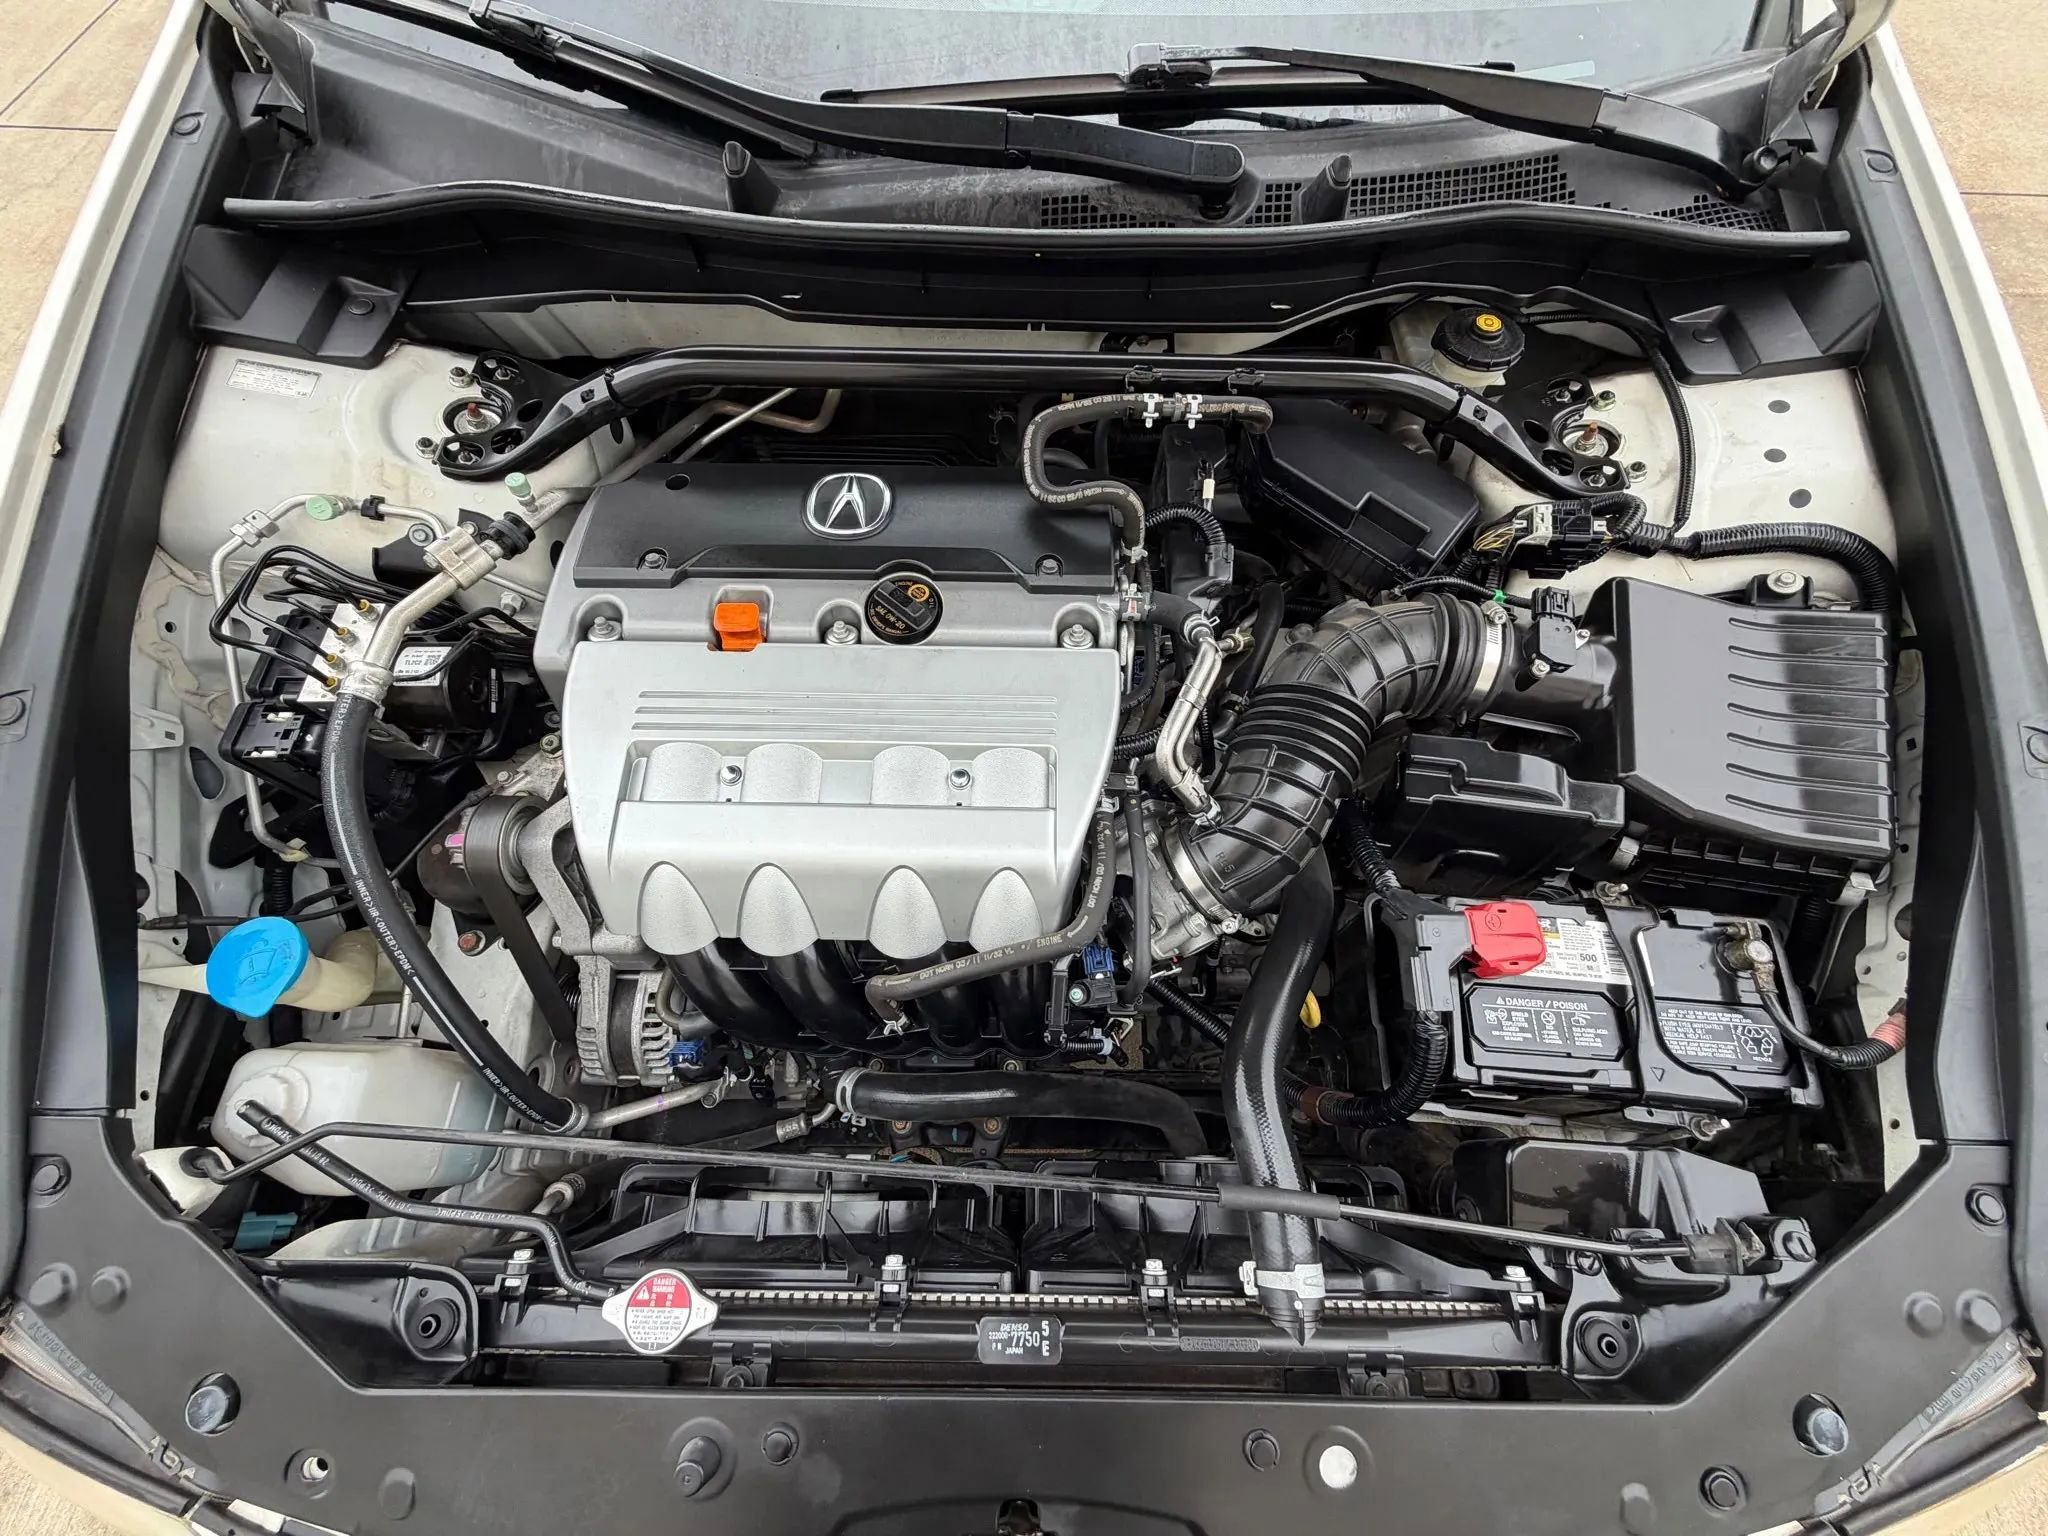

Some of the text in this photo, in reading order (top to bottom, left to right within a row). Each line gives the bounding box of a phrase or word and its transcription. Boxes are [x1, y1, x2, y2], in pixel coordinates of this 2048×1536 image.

[875, 605, 906, 630] SAE 0W-20
[1036, 935, 1062, 949] ENGINE
[1579, 953, 1598, 962] 500
[1505, 997, 1544, 1008] DANGER
[1553, 1000, 1588, 1011] POISON
[653, 1277, 677, 1286] DANGER
[652, 1285, 676, 1293] WARNING
[1000, 1322, 1029, 1332] DENSO
[1041, 1320, 1050, 1337] 5
[1004, 1346, 1024, 1355] JAPAN
[1041, 1340, 1050, 1357] E
